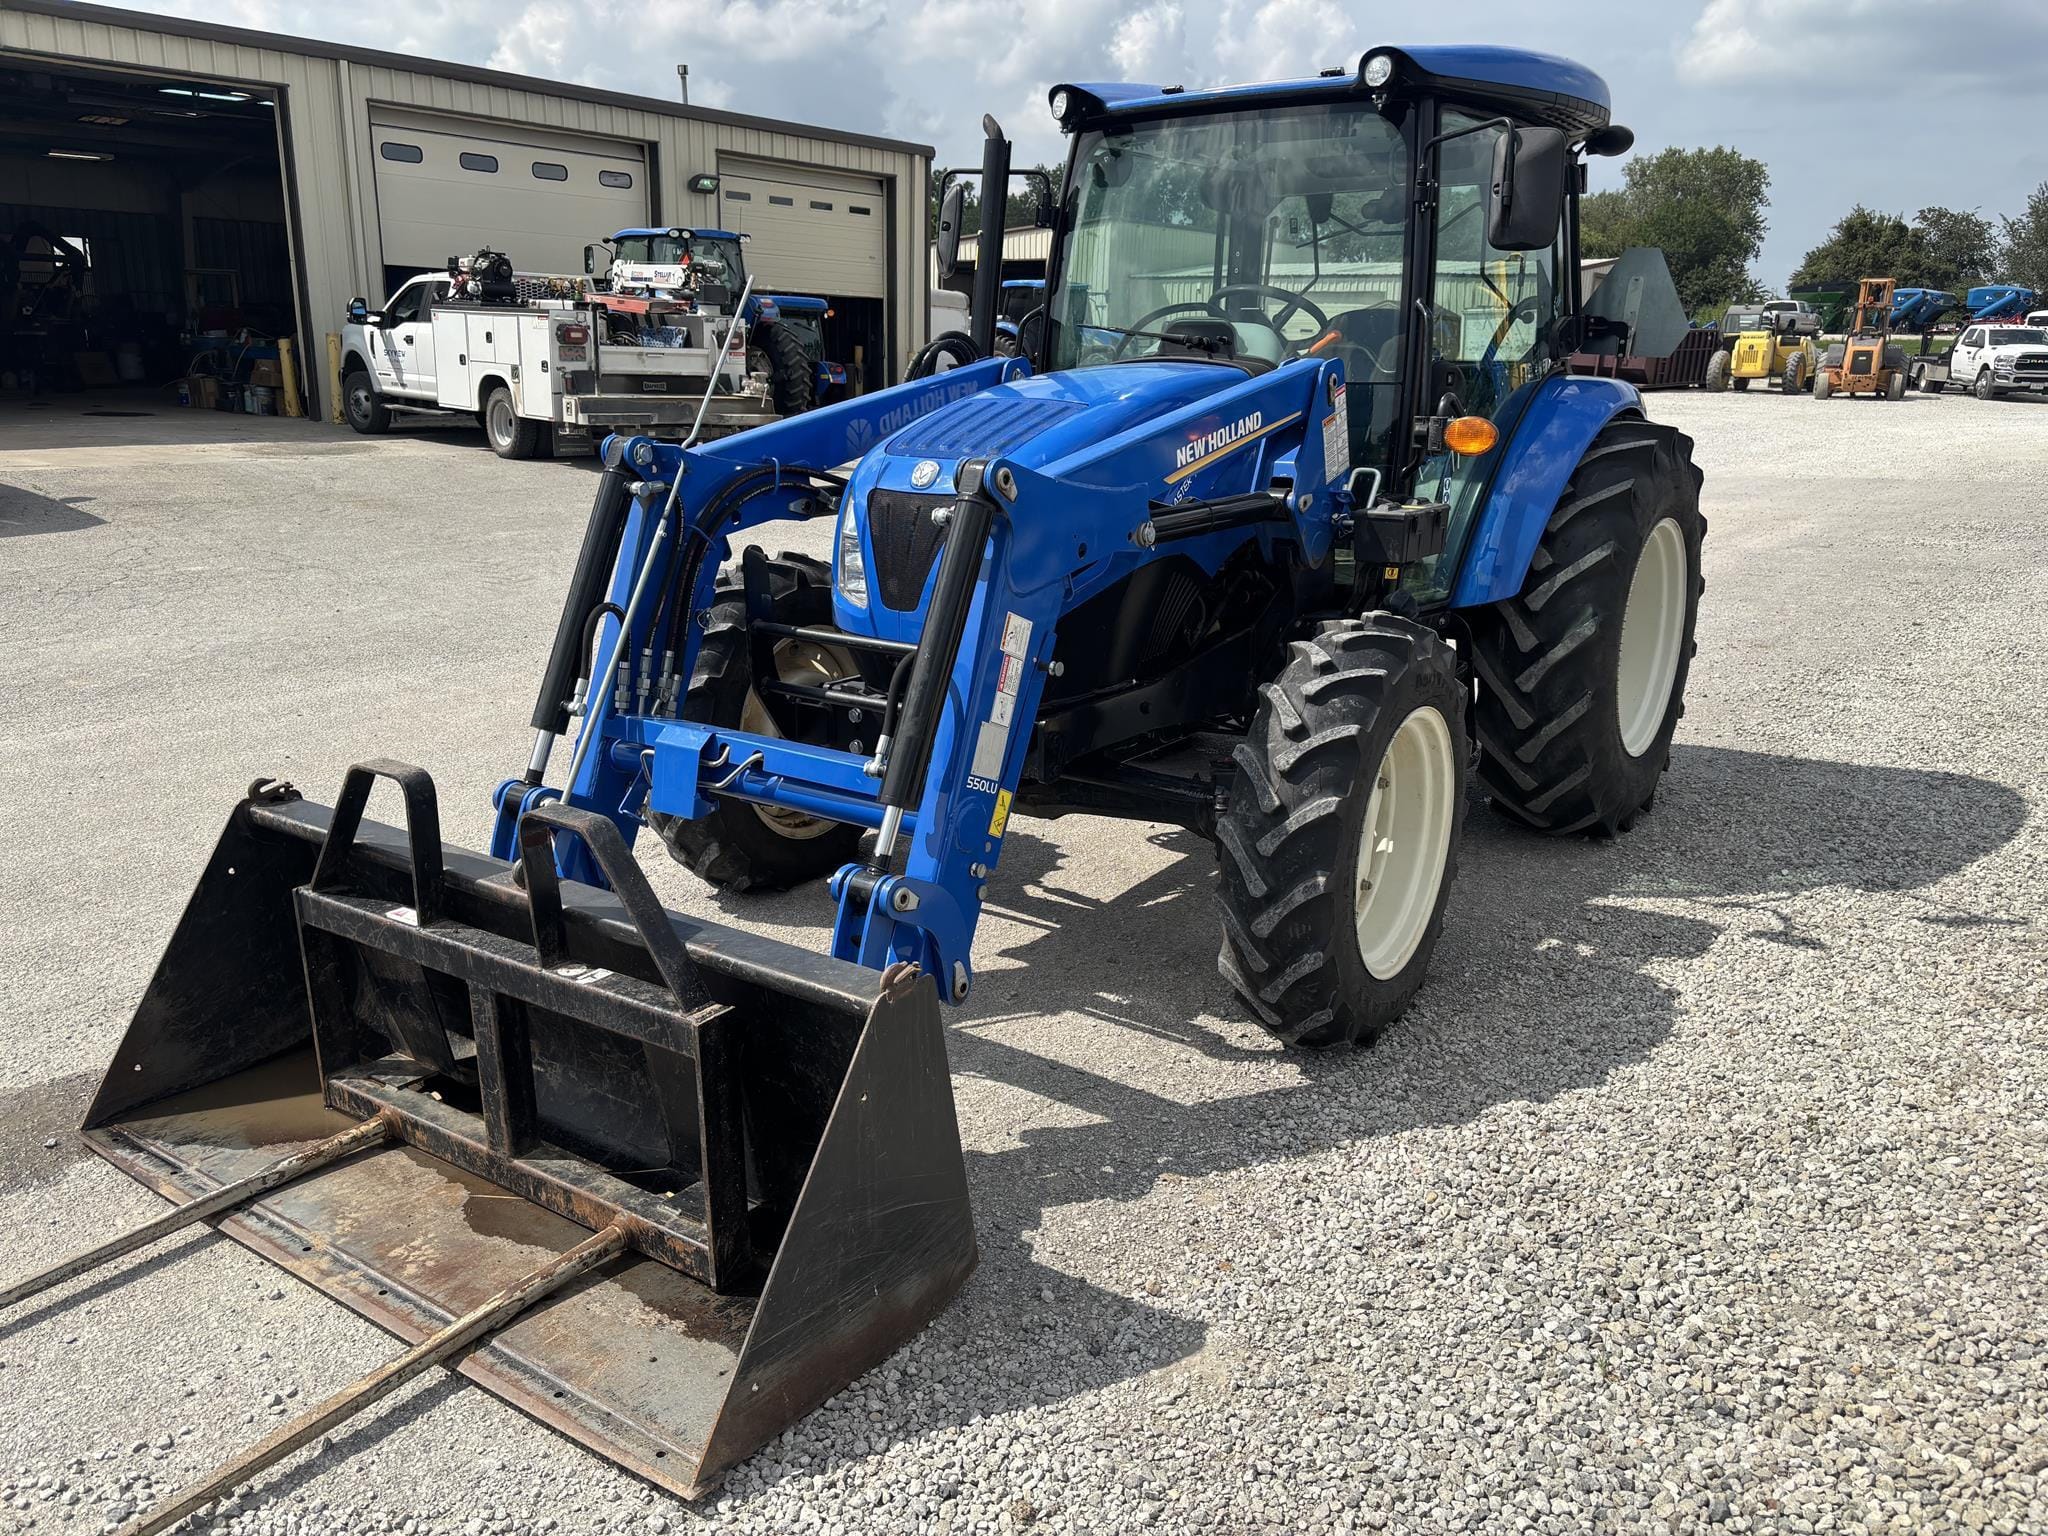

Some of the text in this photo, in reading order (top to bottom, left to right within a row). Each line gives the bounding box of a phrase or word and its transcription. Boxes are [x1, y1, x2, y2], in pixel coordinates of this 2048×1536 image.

[1176, 411, 1262, 469] NEW HOLLAND
[966, 775, 999, 795] 550LU
